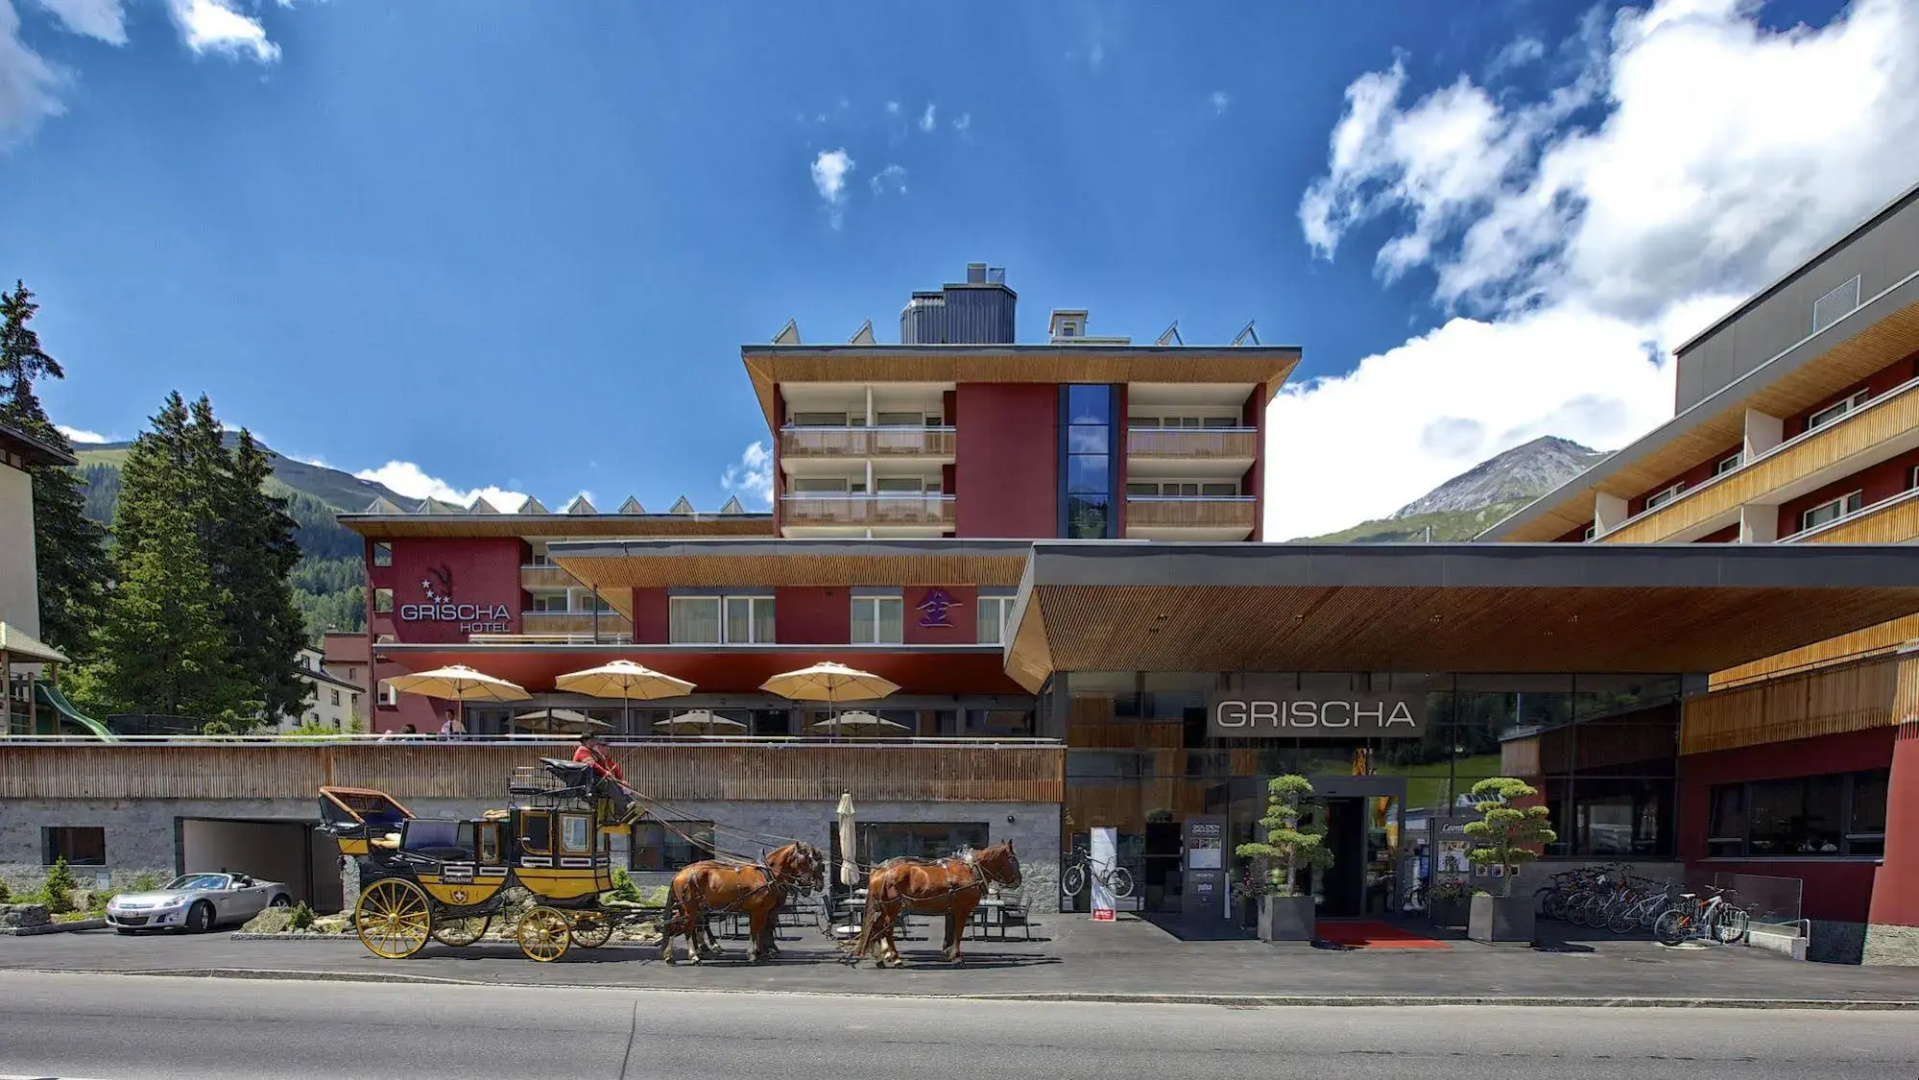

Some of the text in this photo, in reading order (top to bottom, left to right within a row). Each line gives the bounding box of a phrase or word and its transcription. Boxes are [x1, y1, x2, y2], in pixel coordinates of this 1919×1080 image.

[401, 604, 510, 621] GRISCHA
[460, 622, 510, 633] HOTEL
[1217, 701, 1416, 728] GRISCHA
